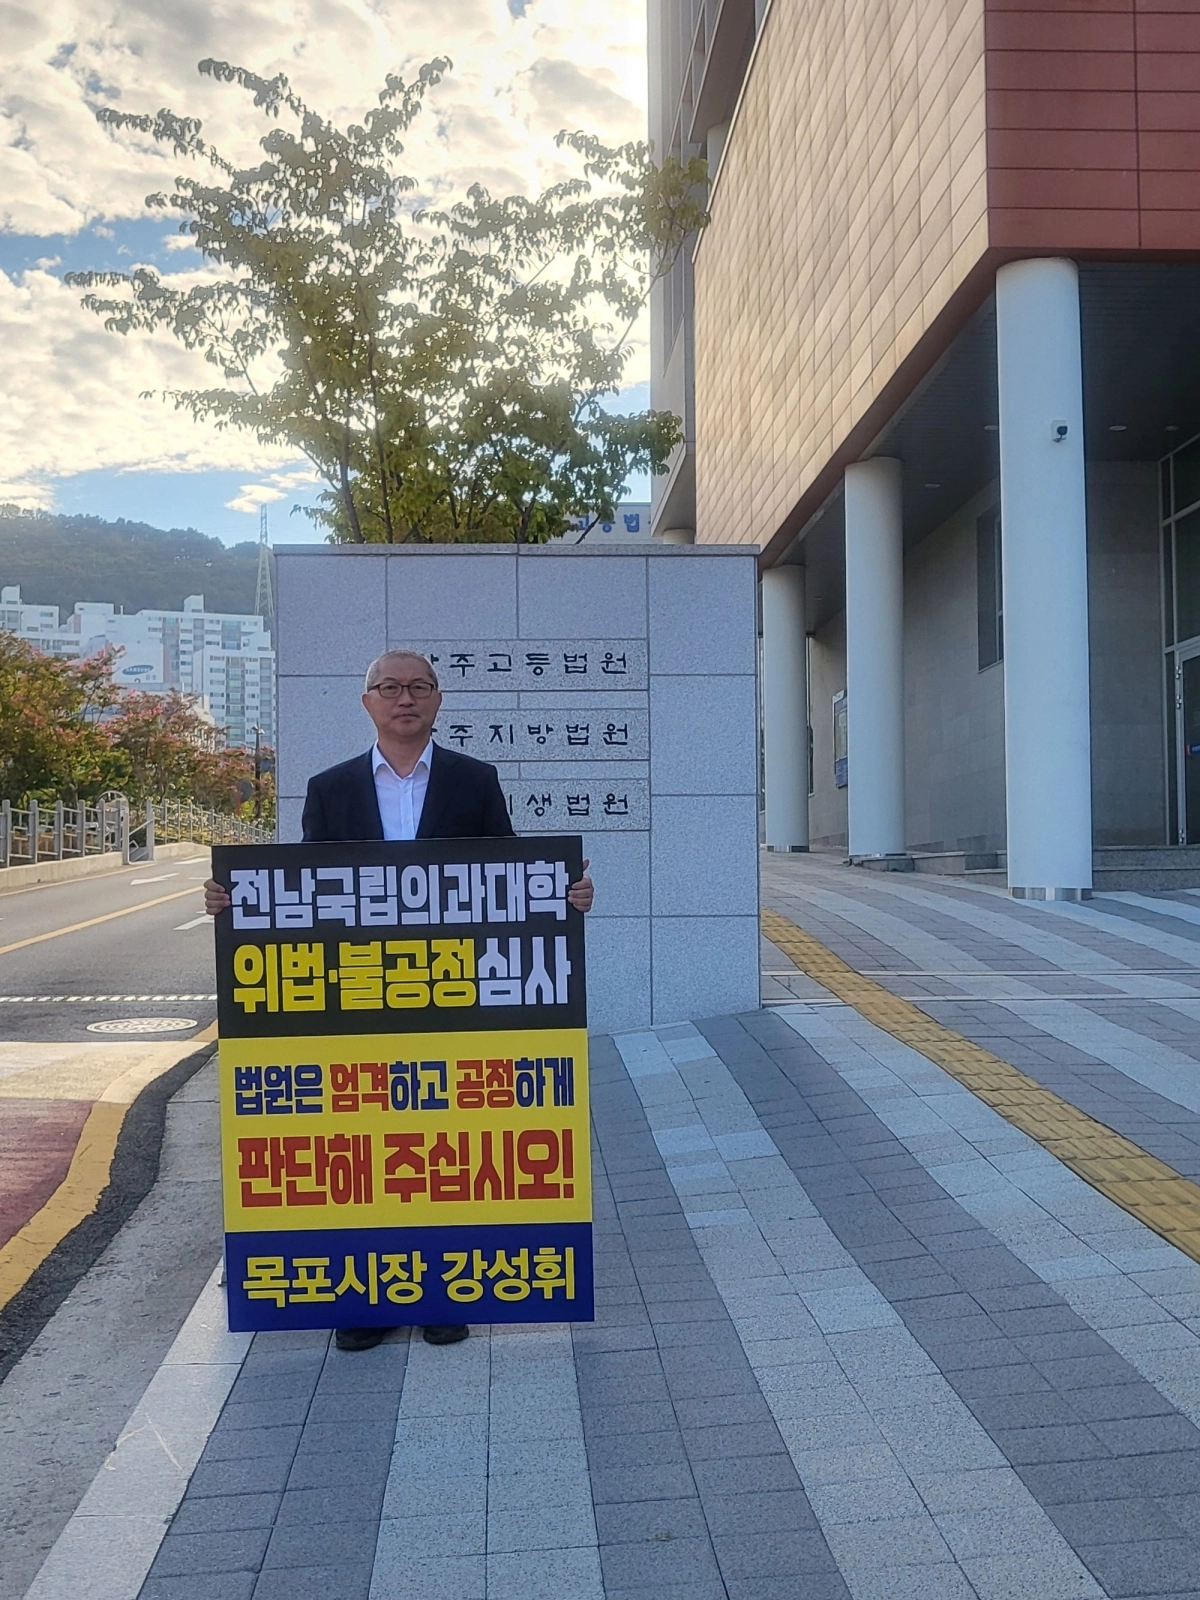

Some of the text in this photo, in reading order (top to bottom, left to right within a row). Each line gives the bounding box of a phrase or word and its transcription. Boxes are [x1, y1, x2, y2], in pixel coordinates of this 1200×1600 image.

[430, 652, 628, 678] 주고등법원
[430, 723, 629, 747] 주지방법원
[507, 793, 629, 817] 생법원
[230, 860, 569, 930] 전남국립의과대학
[234, 1057, 575, 1116] 법원은 엄격하고 공정하게
[237, 1128, 575, 1208] 판단해 주십시오!
[243, 1246, 576, 1308] 목포시장 강성휘
